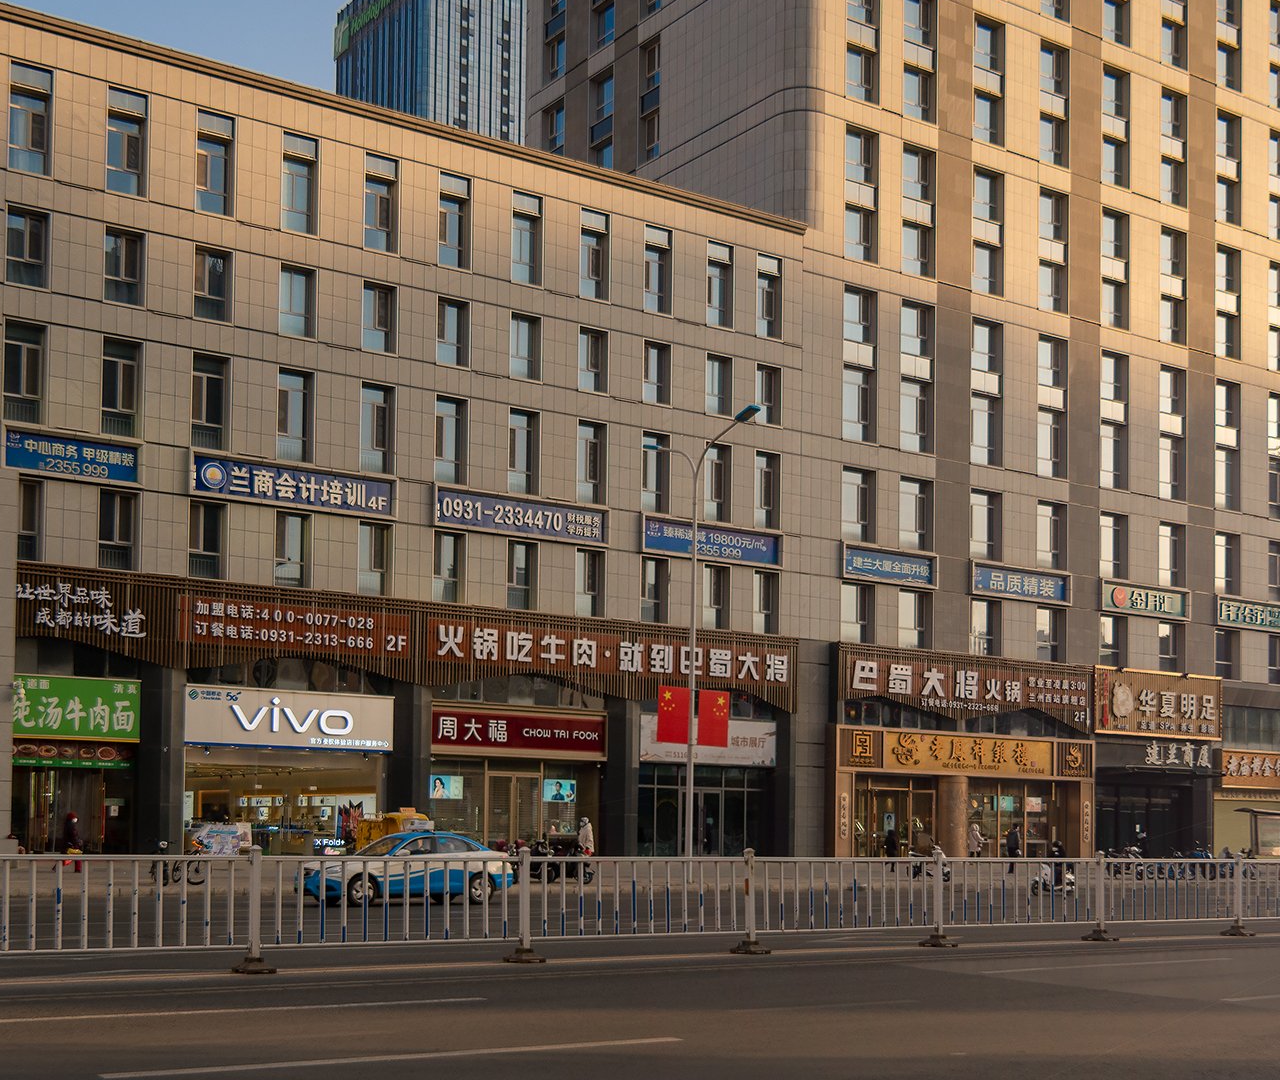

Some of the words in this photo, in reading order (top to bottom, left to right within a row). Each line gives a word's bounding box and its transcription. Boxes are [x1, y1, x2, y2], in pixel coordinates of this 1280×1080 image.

[24, 439, 78, 460] 中心商务
[83, 447, 135, 467] 甲级精装
[46, 458, 80, 474] 2355
[82, 463, 109, 478] 999
[229, 466, 367, 508] 兰商会计培训
[368, 497, 387, 511] 4F
[442, 497, 562, 532] 0931-2334470
[567, 512, 601, 528] 财税服务
[721, 546, 742, 559] 999
[852, 556, 930, 577] 建兰大厦全面升级
[16, 582, 113, 608] 让世界品味
[989, 572, 1055, 597] 品质精装
[35, 608, 147, 638] 成都的味道
[386, 634, 407, 652] 2F
[230, 696, 354, 736] vivo
[1074, 711, 1085, 722] 2F
[1139, 689, 1216, 720] 华夏明足
[438, 716, 508, 742] 周大福
[523, 728, 551, 739] CHOW
[554, 729, 569, 739] TAI
[573, 730, 599, 741] FOOK
[731, 735, 767, 749] 城市展厅
